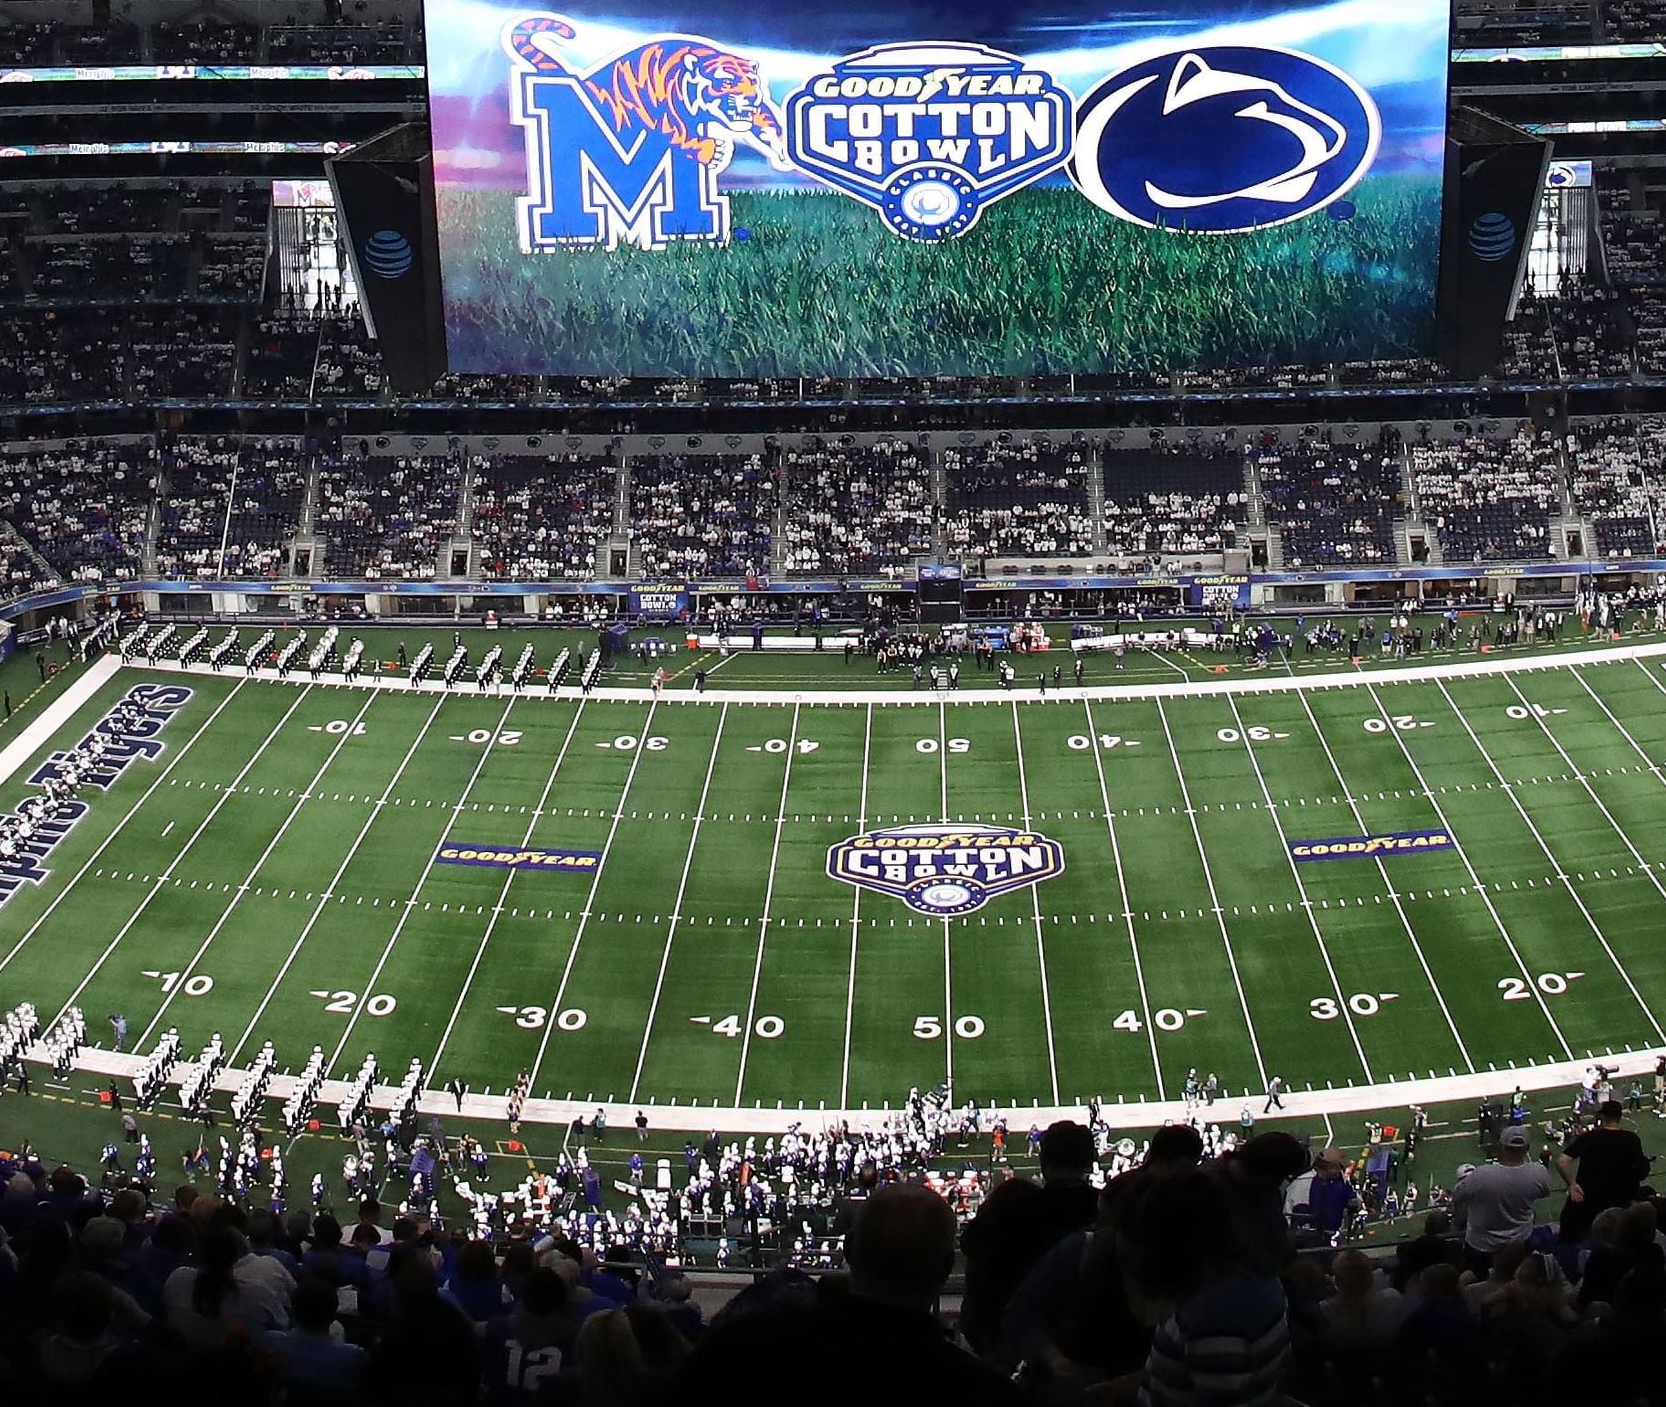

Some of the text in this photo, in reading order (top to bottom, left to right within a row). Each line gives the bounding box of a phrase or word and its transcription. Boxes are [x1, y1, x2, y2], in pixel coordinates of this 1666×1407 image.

[813, 68, 1047, 103] GOODYEAR
[808, 101, 1051, 162] COTTON
[853, 138, 1007, 176] BOWL
[890, 169, 971, 195] CLASSIC
[631, 583, 685, 593] GOODYEAR
[1194, 574, 1248, 585] GOODYEAR
[639, 594, 678, 602] COTTON
[1202, 585, 1239, 593] COTTON
[639, 601, 668, 609] BOWL
[1505, 703, 1551, 719] 10
[325, 720, 367, 736] 10
[1363, 715, 1417, 733] 20
[468, 729, 523, 745] 20
[614, 735, 669, 751] 30
[1067, 734, 1121, 750] 40
[1217, 726, 1271, 742] 30
[764, 739, 819, 754] 40
[915, 738, 971, 753] 50
[853, 833, 1037, 850] GOODYEAR
[1292, 835, 1451, 856] GOODYEAR
[440, 848, 598, 867] GOODYEAR
[848, 846, 1043, 877] COTTON
[884, 864, 1008, 882] BOWL
[161, 972, 214, 996] 10
[1497, 973, 1567, 1000] 20
[324, 990, 397, 1016] 20
[1310, 993, 1379, 1020] 30
[516, 1006, 587, 1031] 30
[712, 1015, 785, 1038] 40
[913, 1015, 985, 1039] 50
[1113, 1008, 1184, 1032] 40
